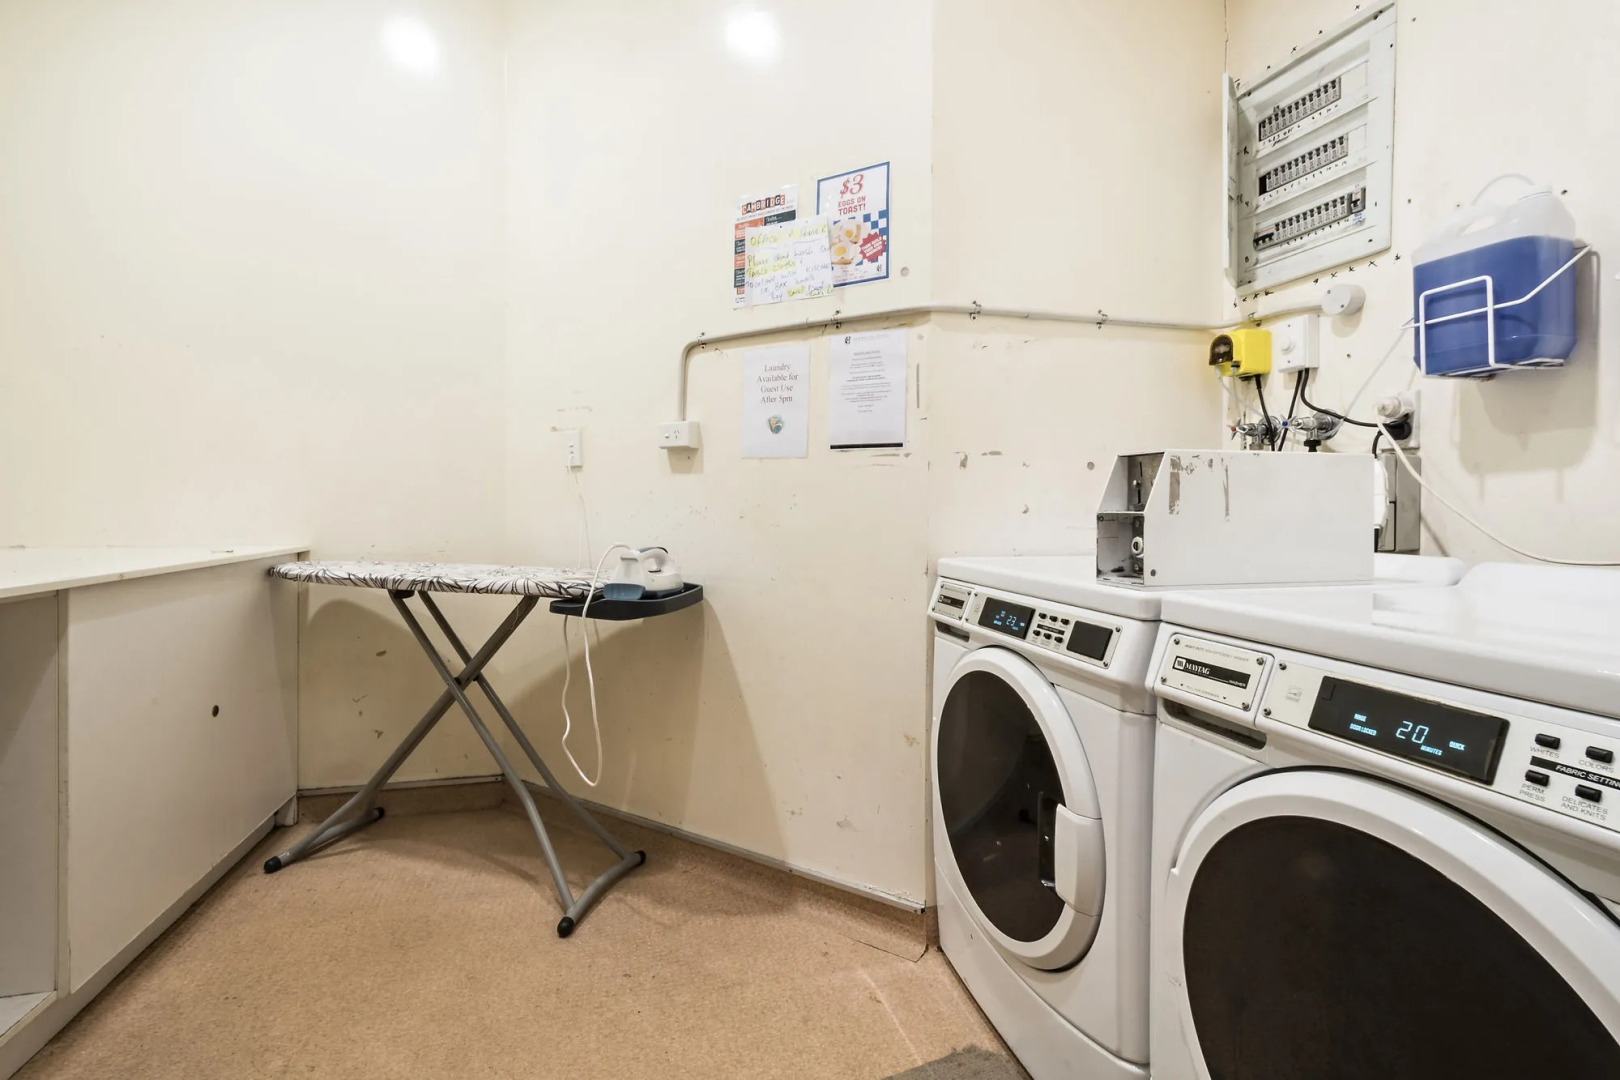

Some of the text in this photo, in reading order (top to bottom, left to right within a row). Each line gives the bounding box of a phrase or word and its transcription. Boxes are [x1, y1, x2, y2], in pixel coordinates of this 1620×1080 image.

[840, 173, 864, 199] $3
[742, 194, 786, 216] CAMBRIDGE
[838, 195, 867, 208] EGGS ON
[838, 203, 867, 216] TOAST!
[764, 363, 791, 373] Laundry
[756, 373, 799, 383] Available for
[760, 385, 779, 393] Guest
[760, 395, 793, 404] After 5pm
[1006, 615, 1018, 627] 23
[1185, 662, 1211, 675] MAYTAG
[1228, 679, 1247, 688] WASHER
[1349, 723, 1377, 736] DOOR LOCKED
[1395, 720, 1430, 744] 20
[1420, 744, 1443, 756] MINUTES
[1448, 740, 1466, 751] QUICK
[1530, 746, 1560, 760] WHITES
[1578, 759, 1615, 774] COLORS
[1555, 764, 1620, 788] FABRIC SETTIN
[1522, 783, 1545, 795] PERM
[1519, 789, 1546, 803] PRESS
[1560, 802, 1607, 822] AND KNITS
[1561, 795, 1609, 816] DELICATES
